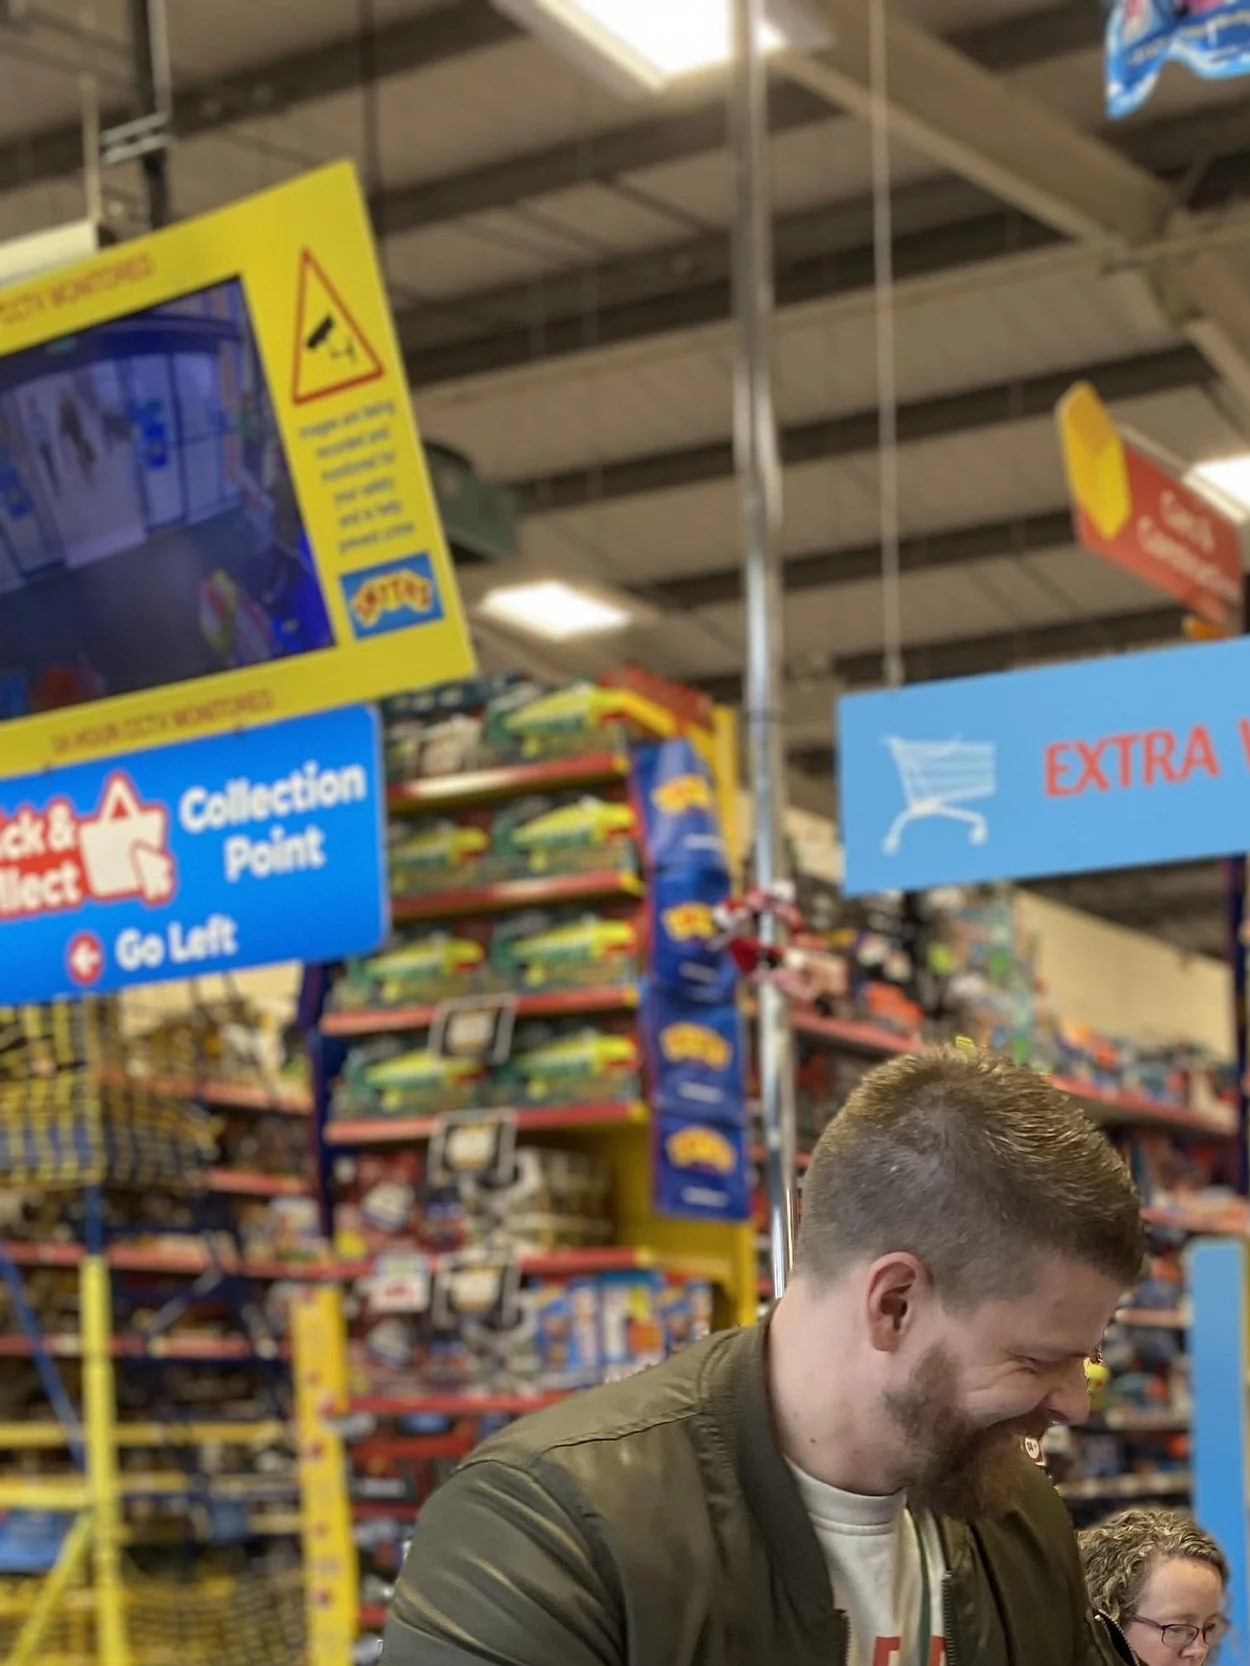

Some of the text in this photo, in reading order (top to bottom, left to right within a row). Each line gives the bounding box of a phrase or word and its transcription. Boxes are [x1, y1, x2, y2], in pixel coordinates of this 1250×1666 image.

[1042, 725, 1221, 798] EXTRA
[180, 758, 368, 834] Collection
[48, 801, 76, 854] &
[224, 824, 327, 884] Point
[115, 913, 240, 972] Go Left
